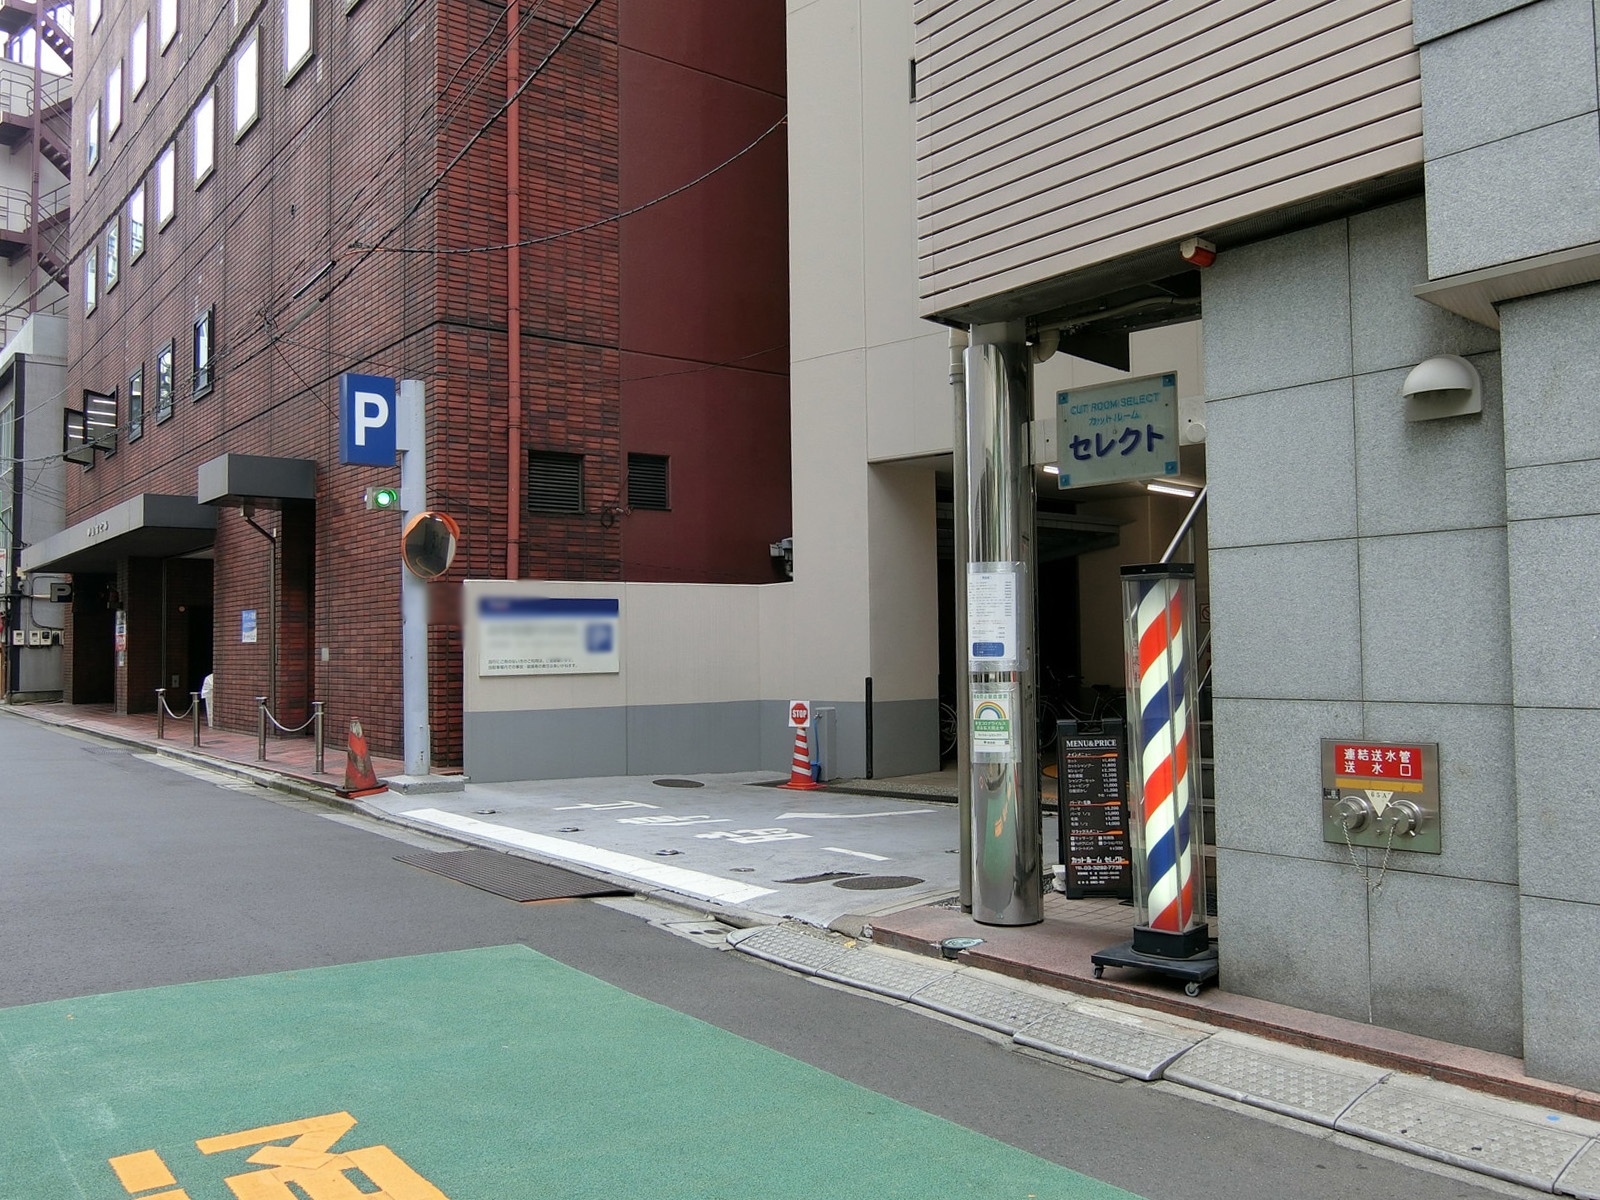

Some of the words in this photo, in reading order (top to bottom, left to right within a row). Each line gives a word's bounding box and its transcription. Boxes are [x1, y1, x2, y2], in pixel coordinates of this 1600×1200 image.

[1070, 404, 1089, 415] CUT
[1091, 400, 1118, 412] ROOM
[1121, 391, 1160, 408] SELECT
[355, 391, 389, 446] P
[1088, 410, 1141, 426] カットルーム
[1068, 424, 1165, 461] セレクト
[52, 584, 71, 602] P
[792, 709, 807, 719] STOP
[1066, 739, 1117, 748] MENU&PRICE
[1344, 748, 1411, 763] 連結送水管
[1344, 761, 1412, 777] 送水口
